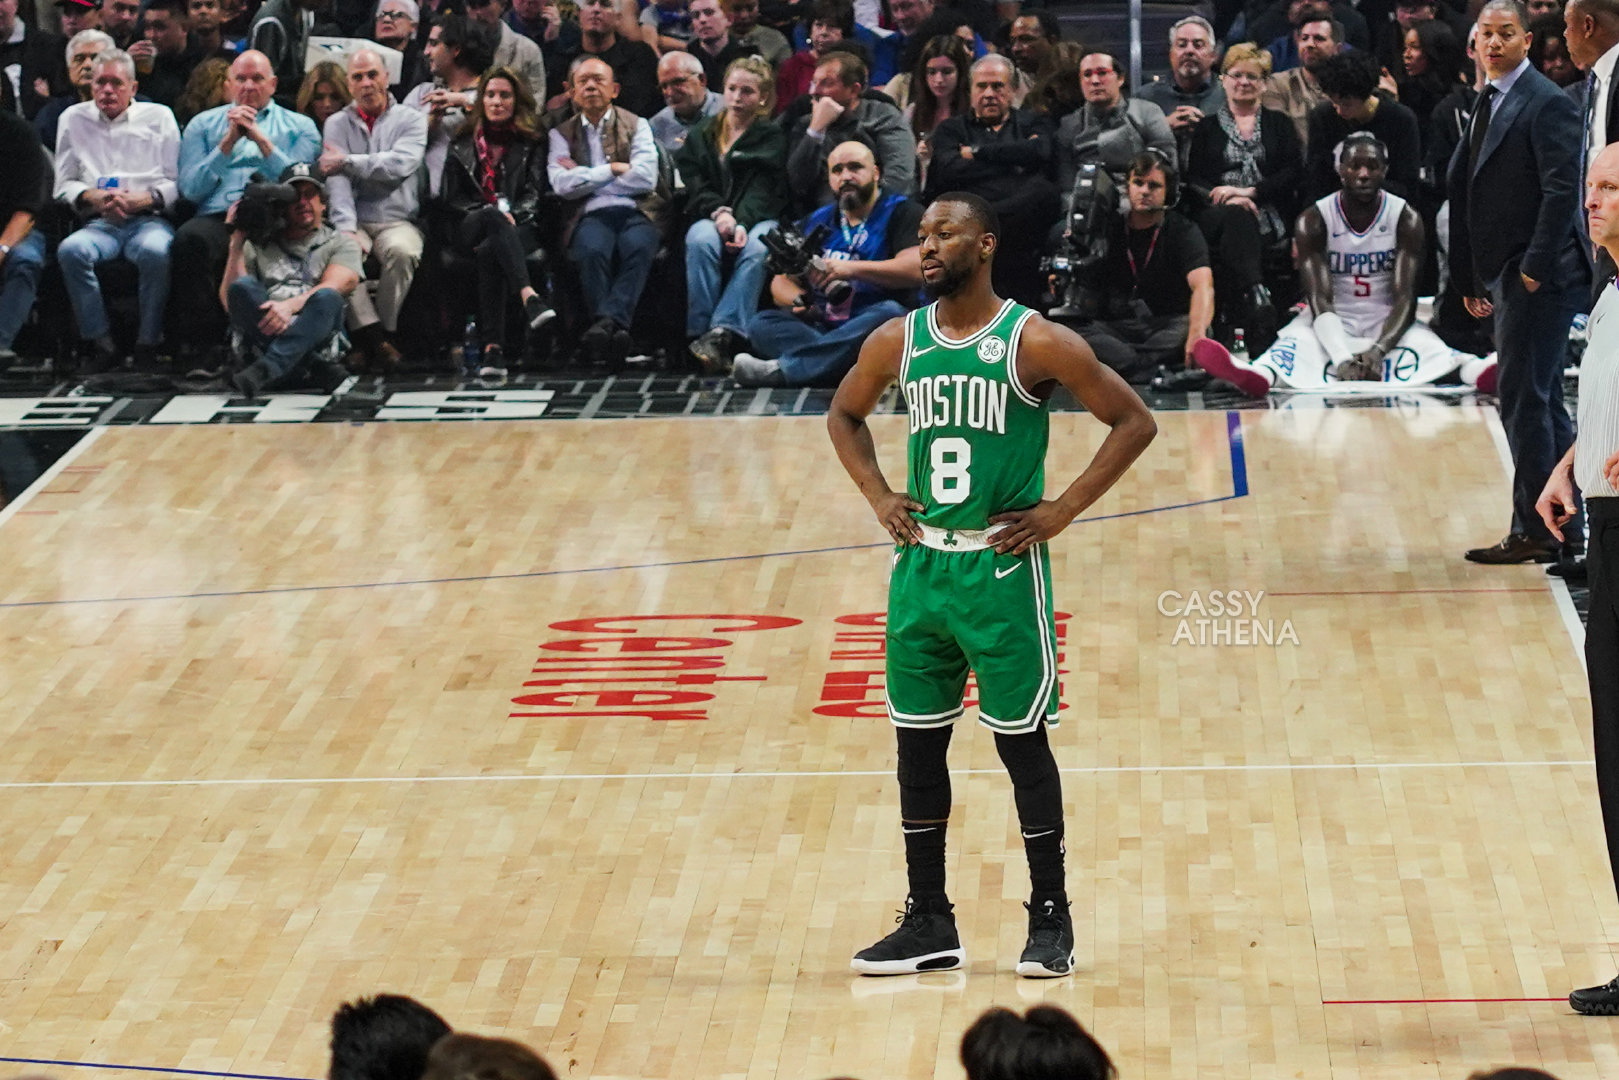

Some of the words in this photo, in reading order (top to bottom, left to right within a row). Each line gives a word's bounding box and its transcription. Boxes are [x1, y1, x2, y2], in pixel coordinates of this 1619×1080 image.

[1328, 249, 1396, 275] CLIPPERS
[1353, 275, 1371, 297] 5
[906, 375, 1008, 434] BOSTON
[930, 437, 972, 504] 8
[508, 614, 804, 721] Center
